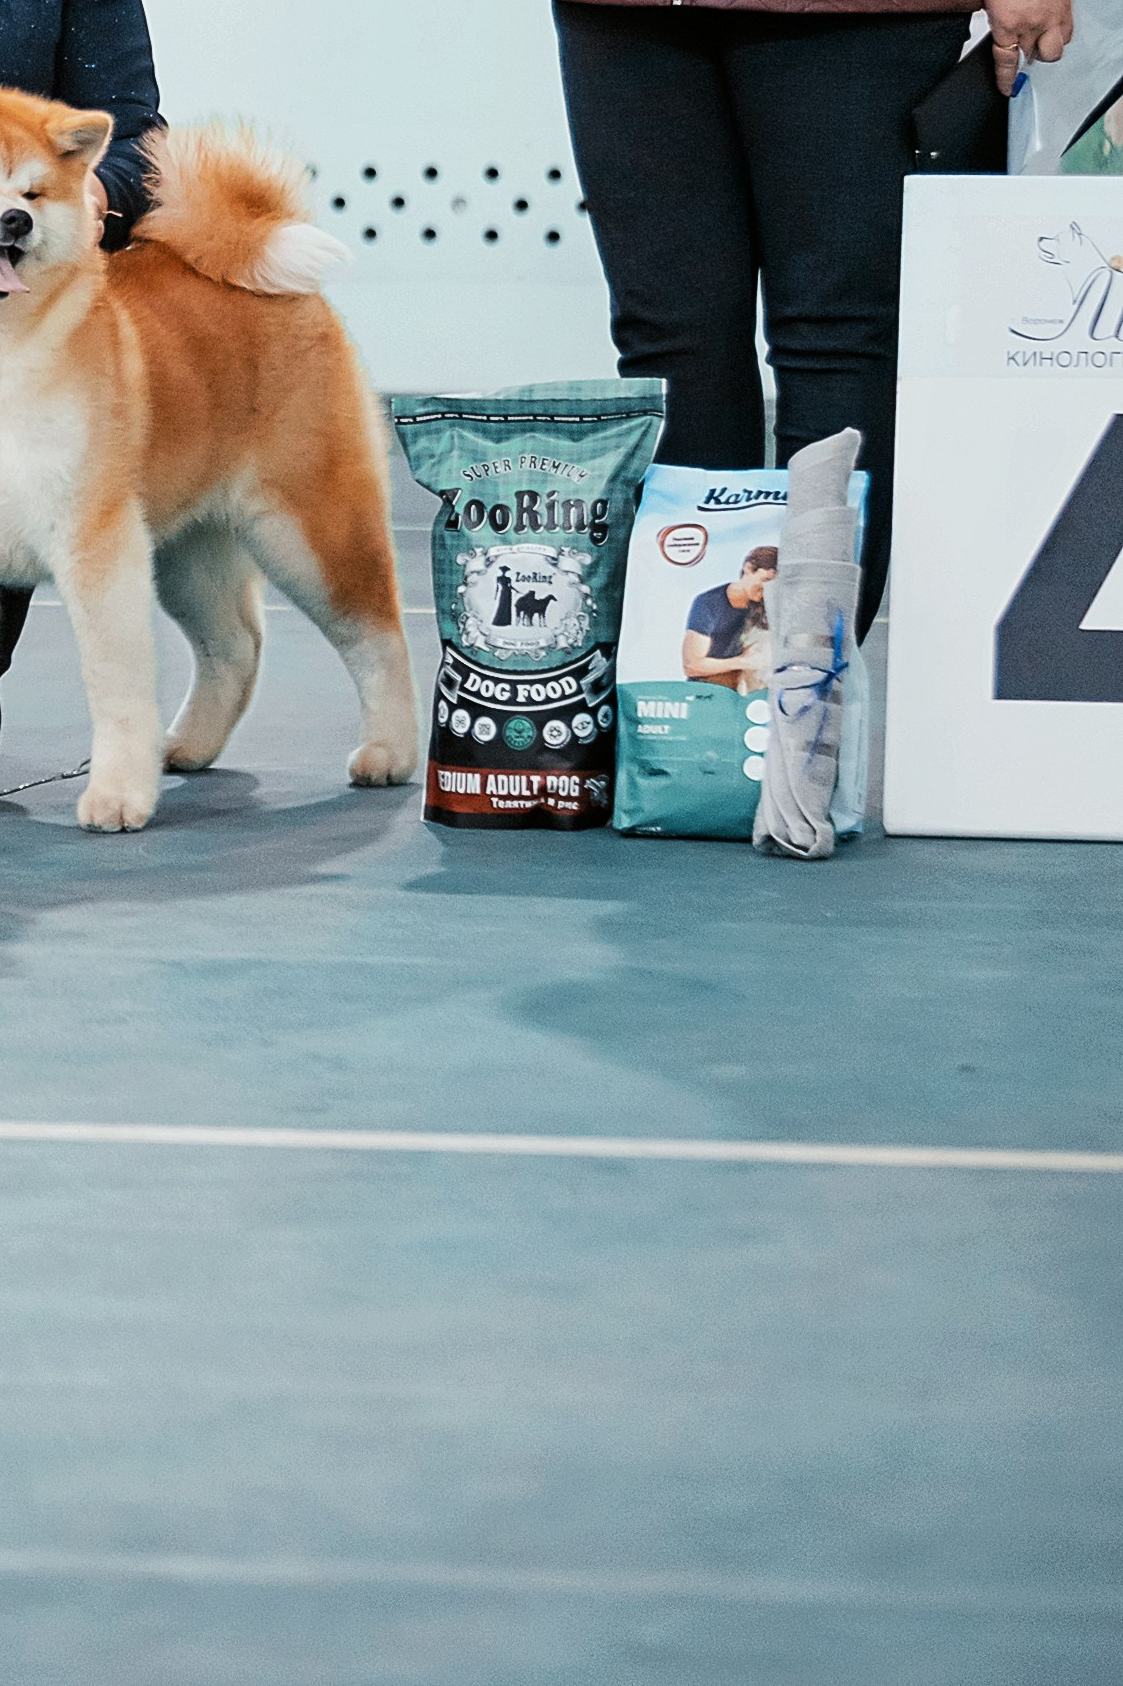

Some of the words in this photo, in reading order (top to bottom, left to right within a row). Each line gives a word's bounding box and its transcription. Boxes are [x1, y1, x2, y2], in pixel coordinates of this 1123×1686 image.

[461, 458, 512, 482] SUPER
[518, 455, 589, 483] PREMIUM
[439, 487, 611, 546] ZooRing
[464, 673, 511, 701] DOG
[516, 676, 578, 702] FOOD
[637, 700, 688, 719] MINI
[486, 773, 541, 795] ADULT
[546, 774, 580, 797] DOG
